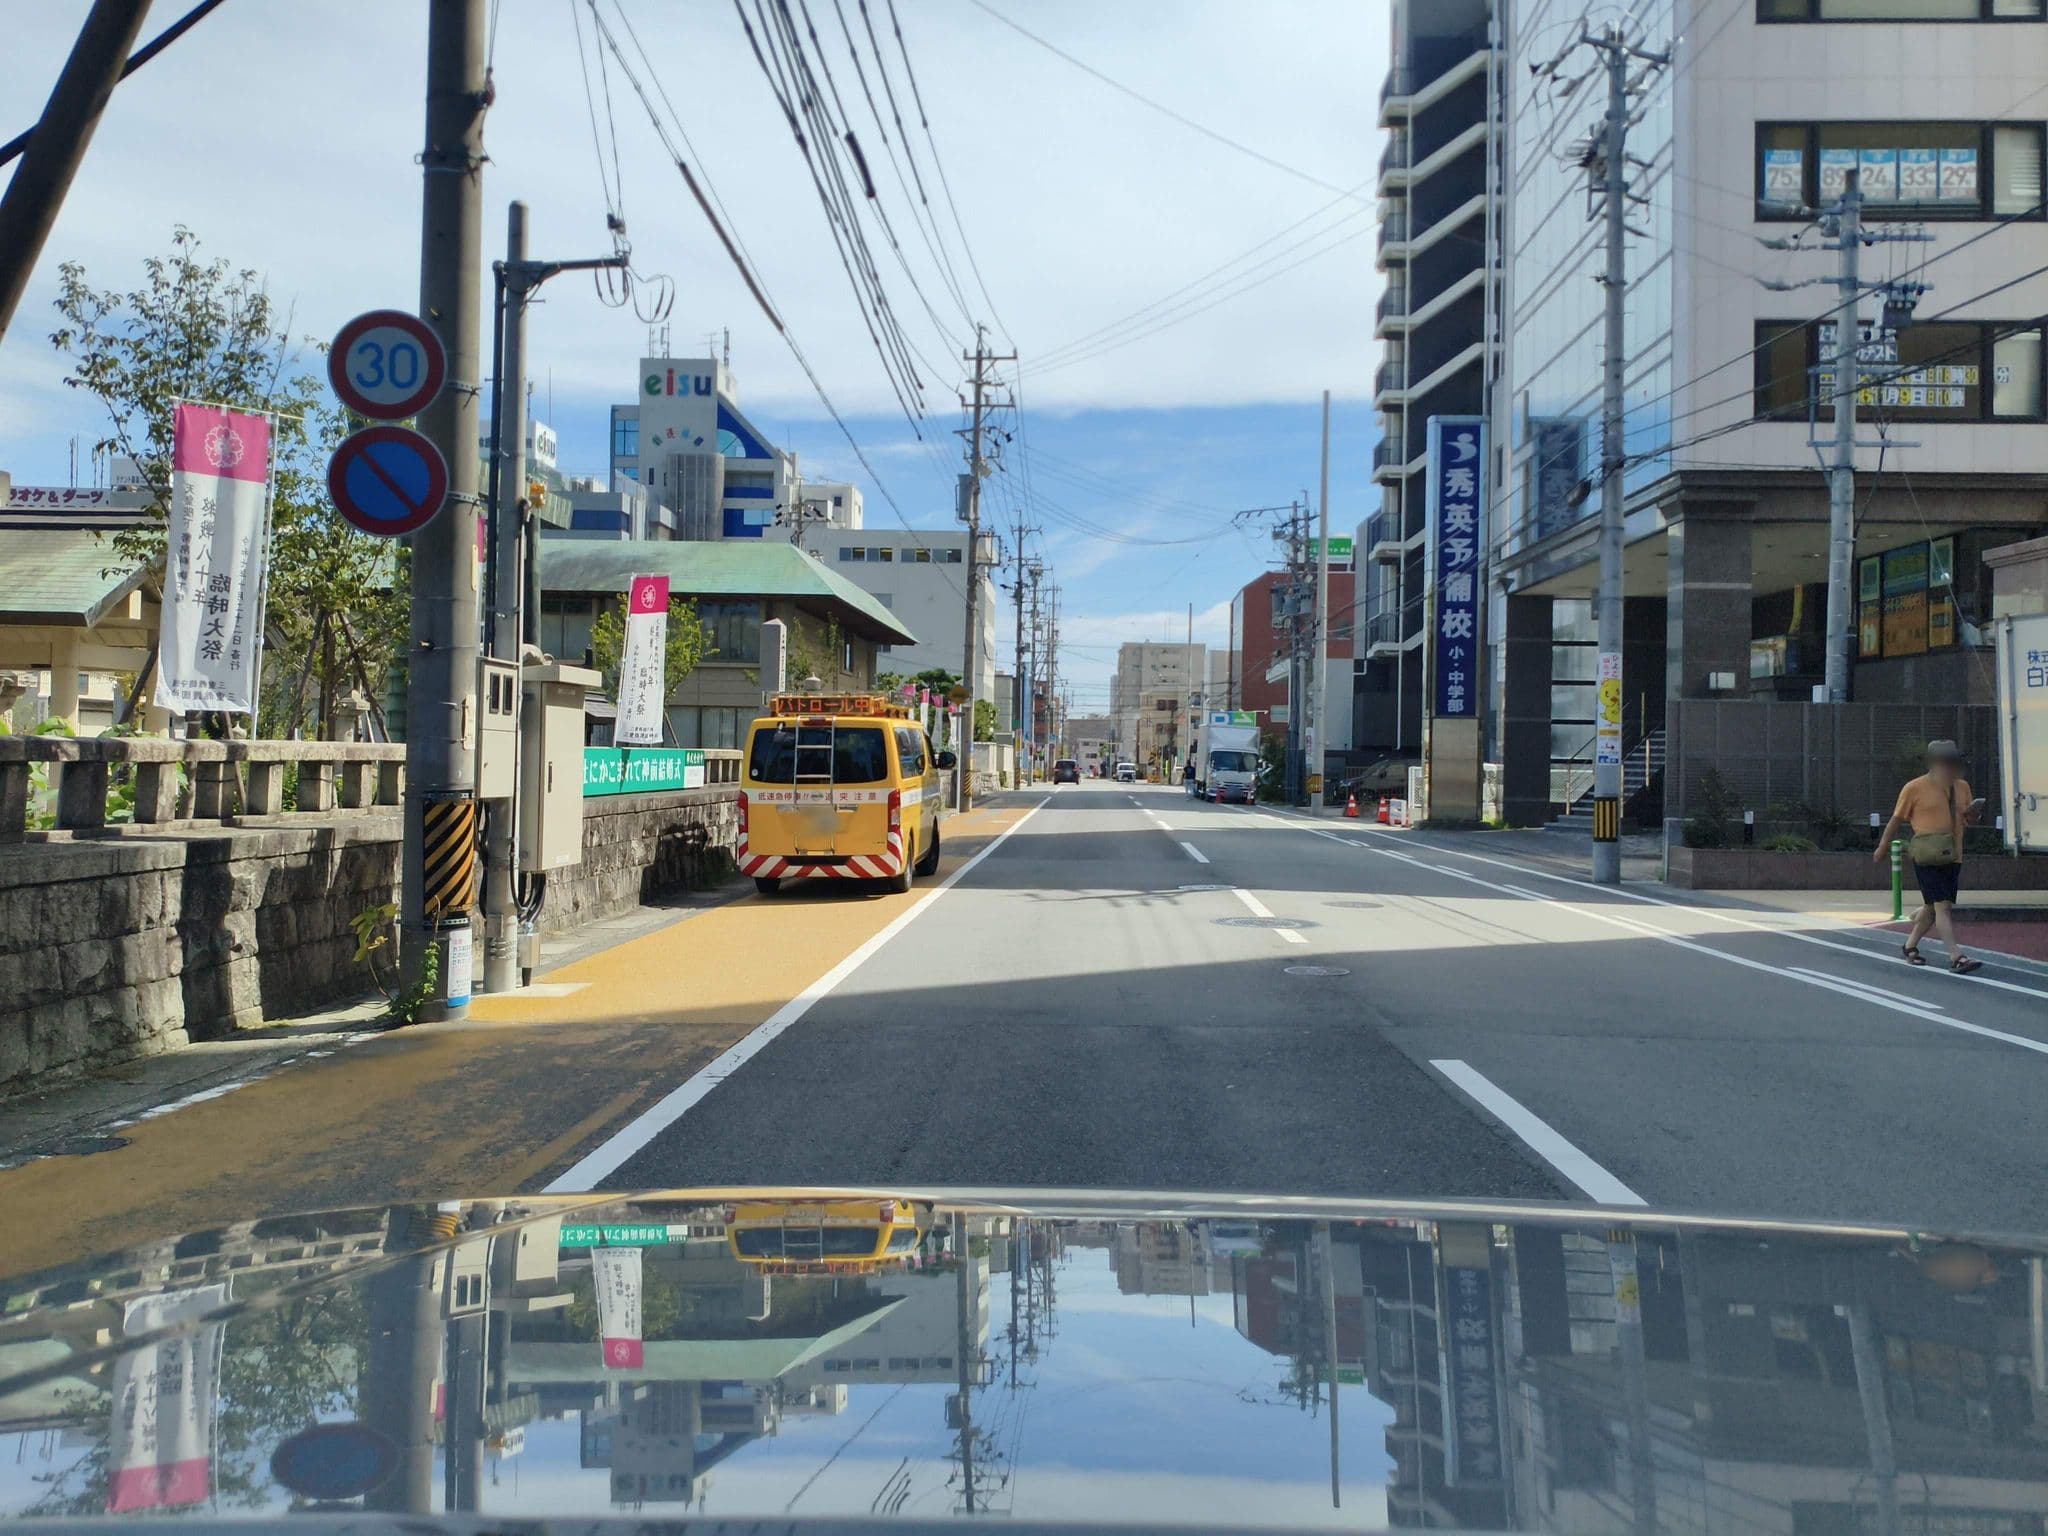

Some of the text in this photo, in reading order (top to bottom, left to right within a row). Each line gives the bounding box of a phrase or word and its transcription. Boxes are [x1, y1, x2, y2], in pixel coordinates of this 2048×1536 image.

[355, 342, 419, 389] 30
[645, 368, 712, 397] eisu
[1442, 467, 1475, 713] 秀英予備校 小・中学部
[779, 698, 869, 712] パトロール中
